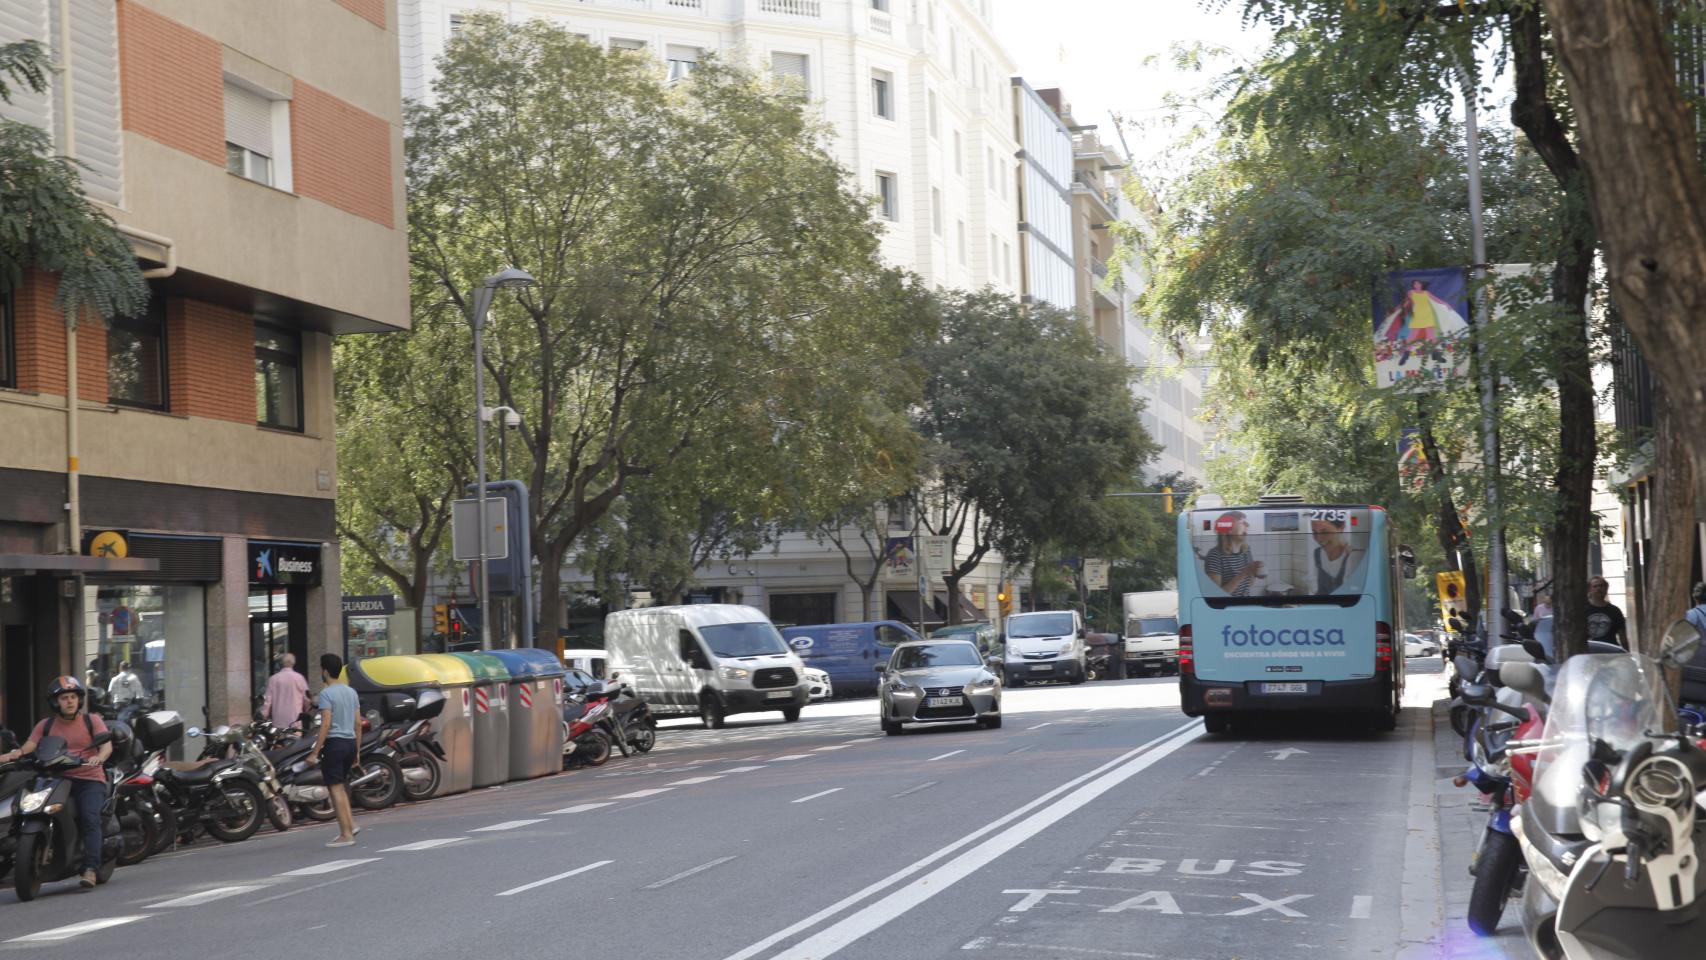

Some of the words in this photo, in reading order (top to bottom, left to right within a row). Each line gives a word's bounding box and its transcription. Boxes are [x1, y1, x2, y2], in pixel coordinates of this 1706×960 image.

[1310, 510, 1347, 522] 2735
[278, 557, 312, 572] Business
[1221, 624, 1346, 646] fotocasa
[1103, 858, 1305, 876] BUS
[1001, 889, 1373, 919] TAXI
